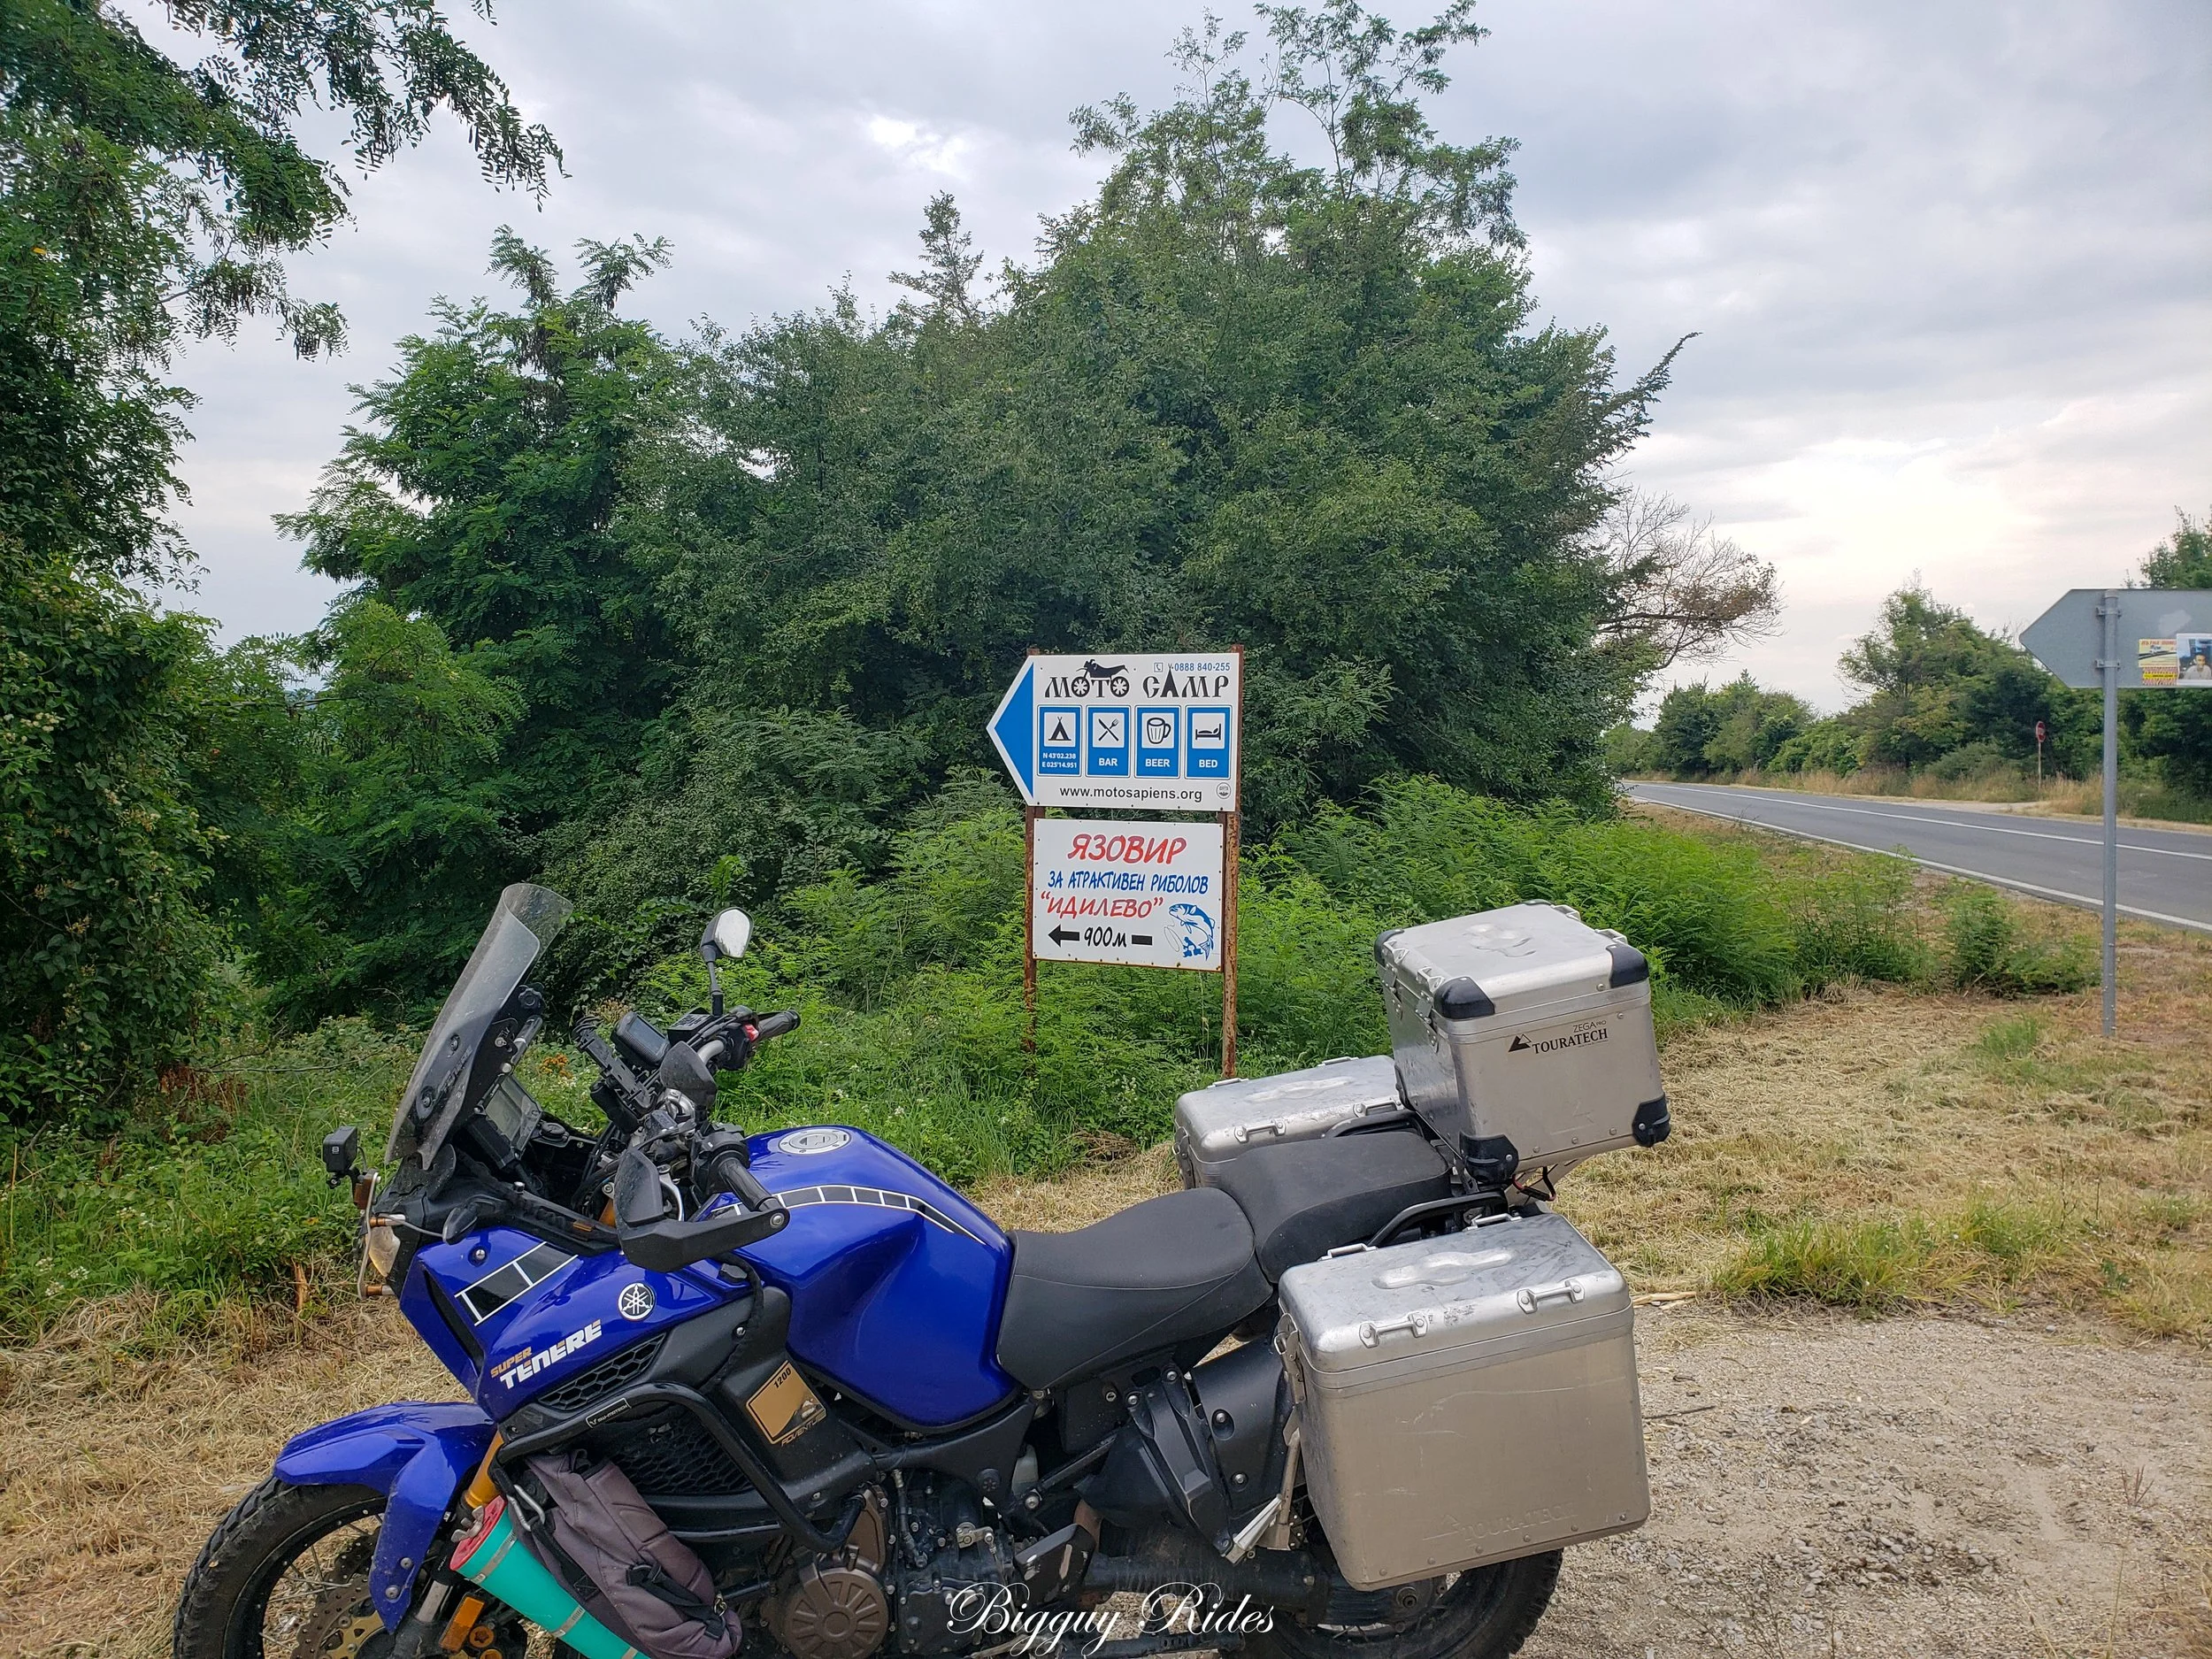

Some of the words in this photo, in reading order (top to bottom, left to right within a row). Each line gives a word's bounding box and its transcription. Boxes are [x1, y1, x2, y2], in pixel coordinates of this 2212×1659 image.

[1044, 675, 1130, 698] MOTO
[1142, 664, 1229, 698] CAMP
[1098, 757, 1118, 766] BAR
[1145, 758, 1170, 768] BEER
[1199, 759, 1218, 769] BED
[1059, 786, 1202, 803] www.motosapiens.org
[1067, 833, 1187, 864] ЯЗОВИР
[1048, 871, 1063, 888] ЗА
[1067, 871, 1145, 891] АТРАКТИВЕН
[1150, 874, 1209, 895] РИБОЛОВ
[1573, 1022, 1596, 1033] ZEGA
[1532, 1028, 1608, 1054] TOURATECH
[490, 1347, 533, 1379] SUPER
[773, 1367, 792, 1388] 1200
